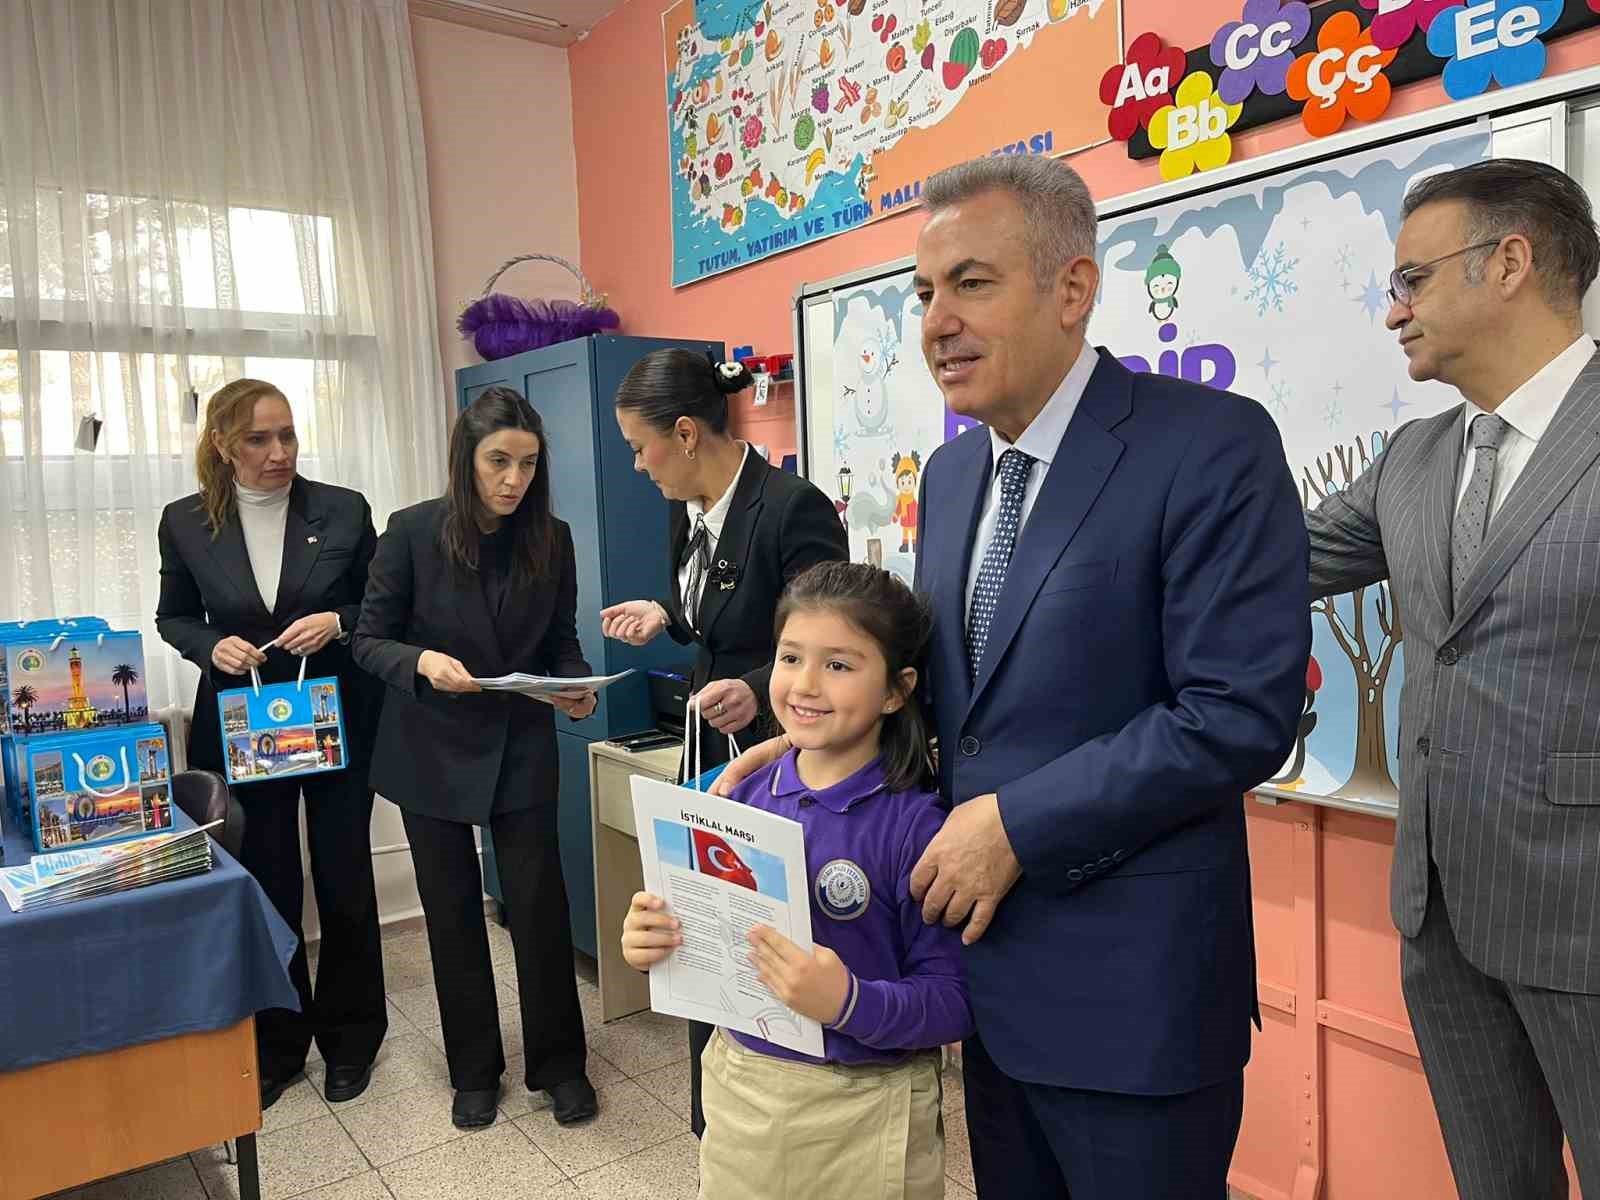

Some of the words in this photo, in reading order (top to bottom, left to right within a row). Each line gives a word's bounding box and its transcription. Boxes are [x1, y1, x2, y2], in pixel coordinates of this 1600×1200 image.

[1224, 21, 1292, 70] Cc
[1455, 1, 1541, 61] Ee
[1113, 62, 1170, 109] Aa
[1307, 45, 1382, 108] Çç
[1167, 99, 1228, 151] Bb
[698, 248, 741, 274] TUTUM,
[746, 226, 798, 257] YATIRIM
[804, 216, 825, 237] VE
[831, 201, 873, 228] TÜRK
[681, 809, 723, 832] İSTİKLAL
